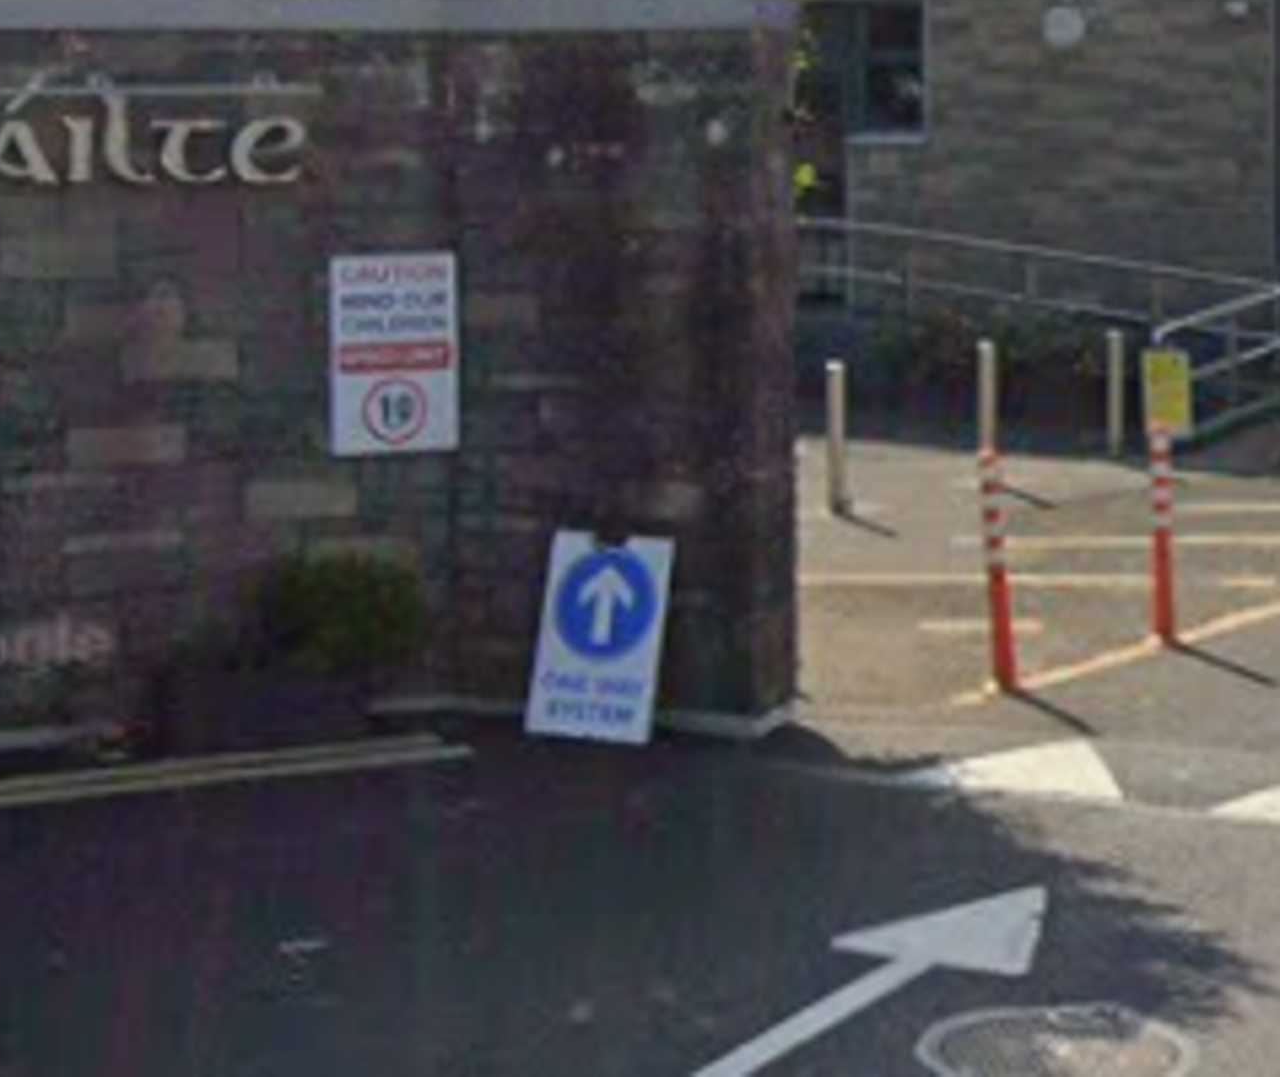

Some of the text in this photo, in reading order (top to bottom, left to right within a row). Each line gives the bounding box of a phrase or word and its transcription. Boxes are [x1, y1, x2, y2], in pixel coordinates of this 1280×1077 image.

[339, 263, 448, 285] CAUTION
[339, 291, 448, 311] MIND OUR
[339, 315, 449, 336] CHILDREN
[540, 673, 589, 695] ONE
[546, 697, 636, 722] SYSTEM
